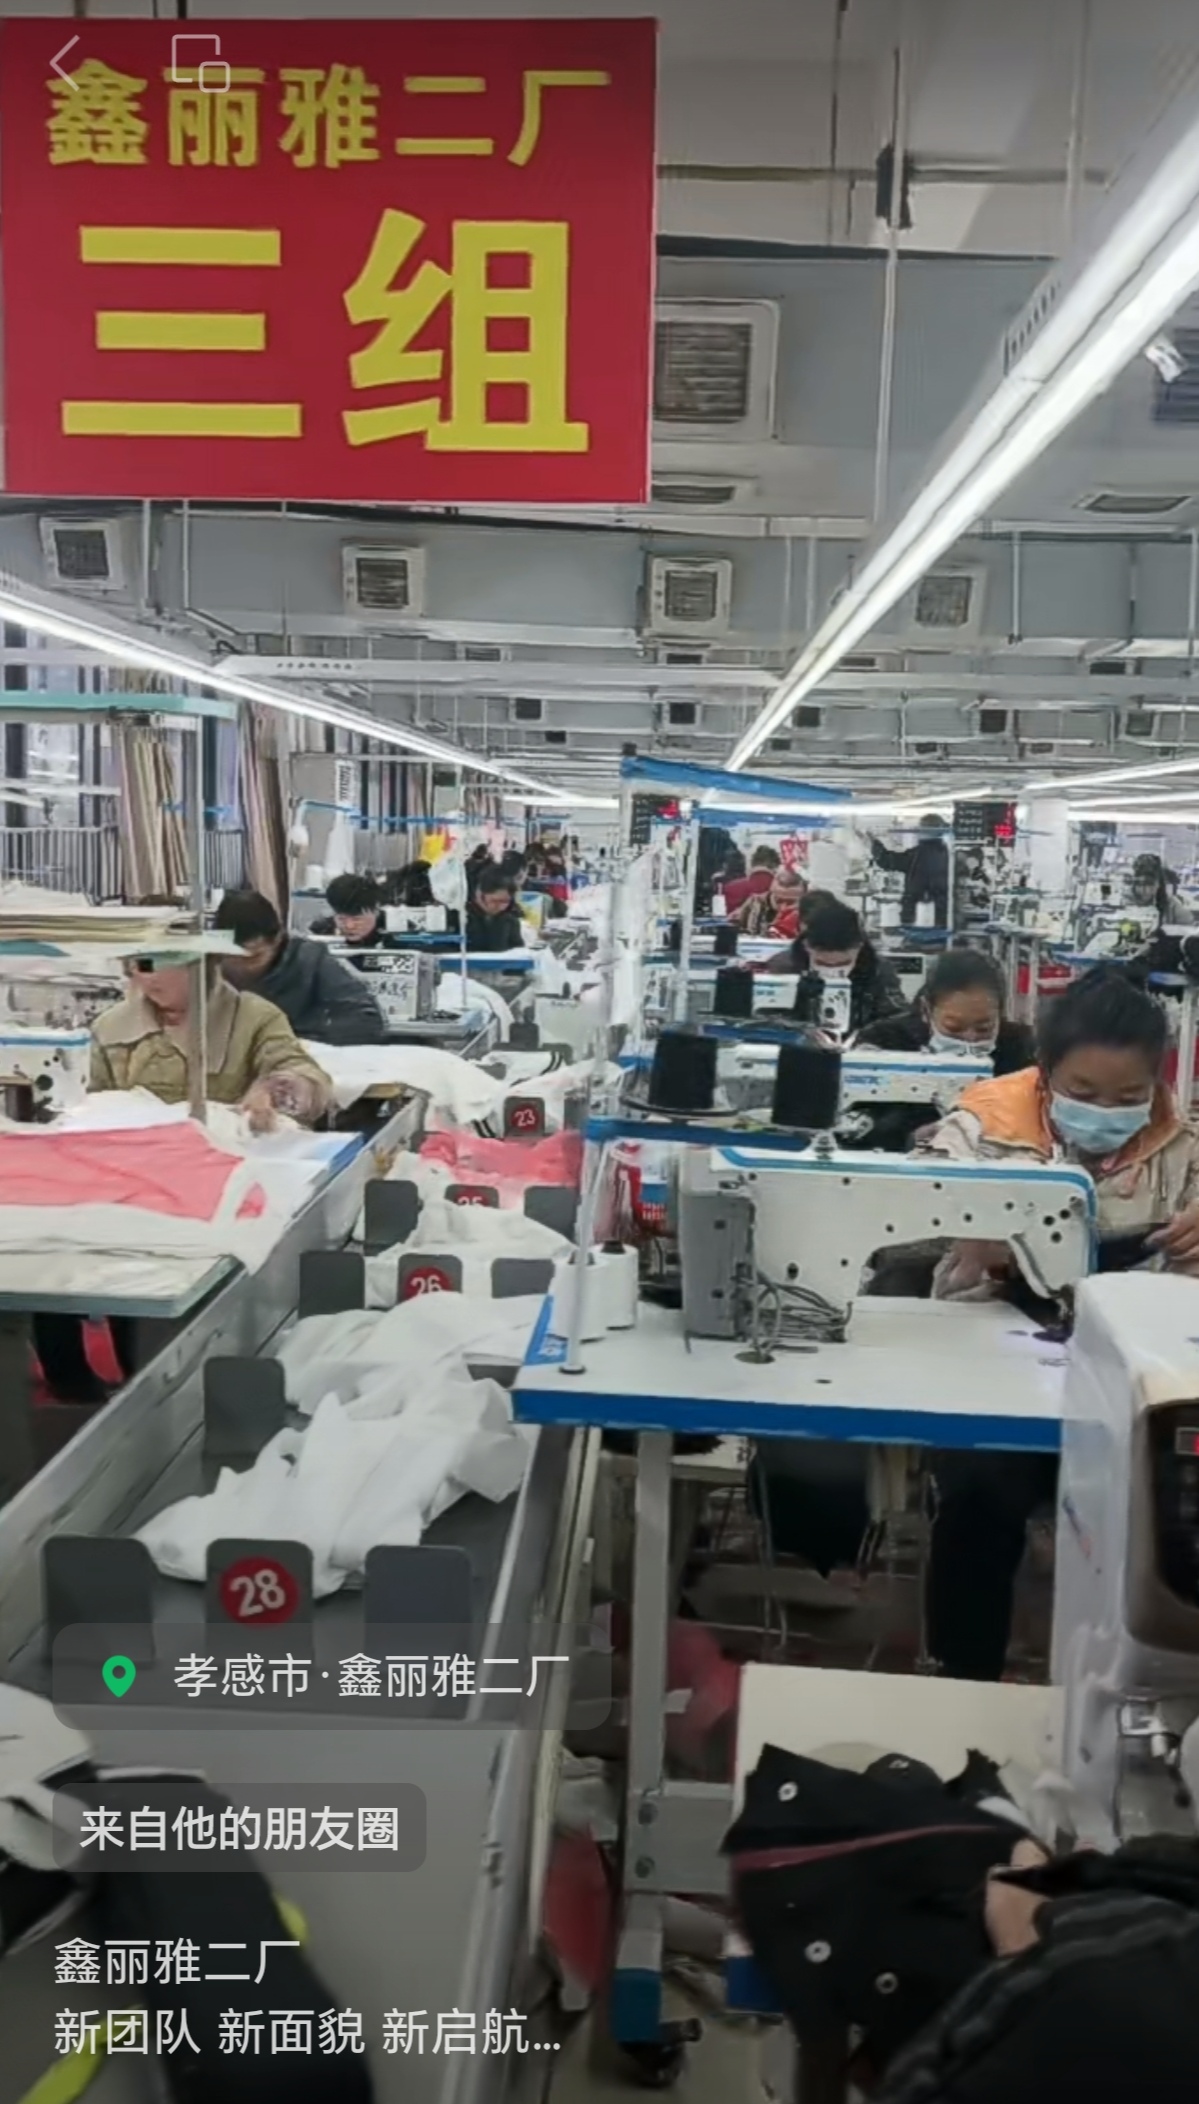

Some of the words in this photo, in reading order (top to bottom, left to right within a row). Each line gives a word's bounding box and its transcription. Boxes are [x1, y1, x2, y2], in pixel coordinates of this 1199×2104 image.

[46, 58, 611, 168] 鑫丽雅二厂
[62, 208, 590, 453] 三组
[514, 1108, 536, 1127] 23
[229, 1568, 286, 1617] 28
